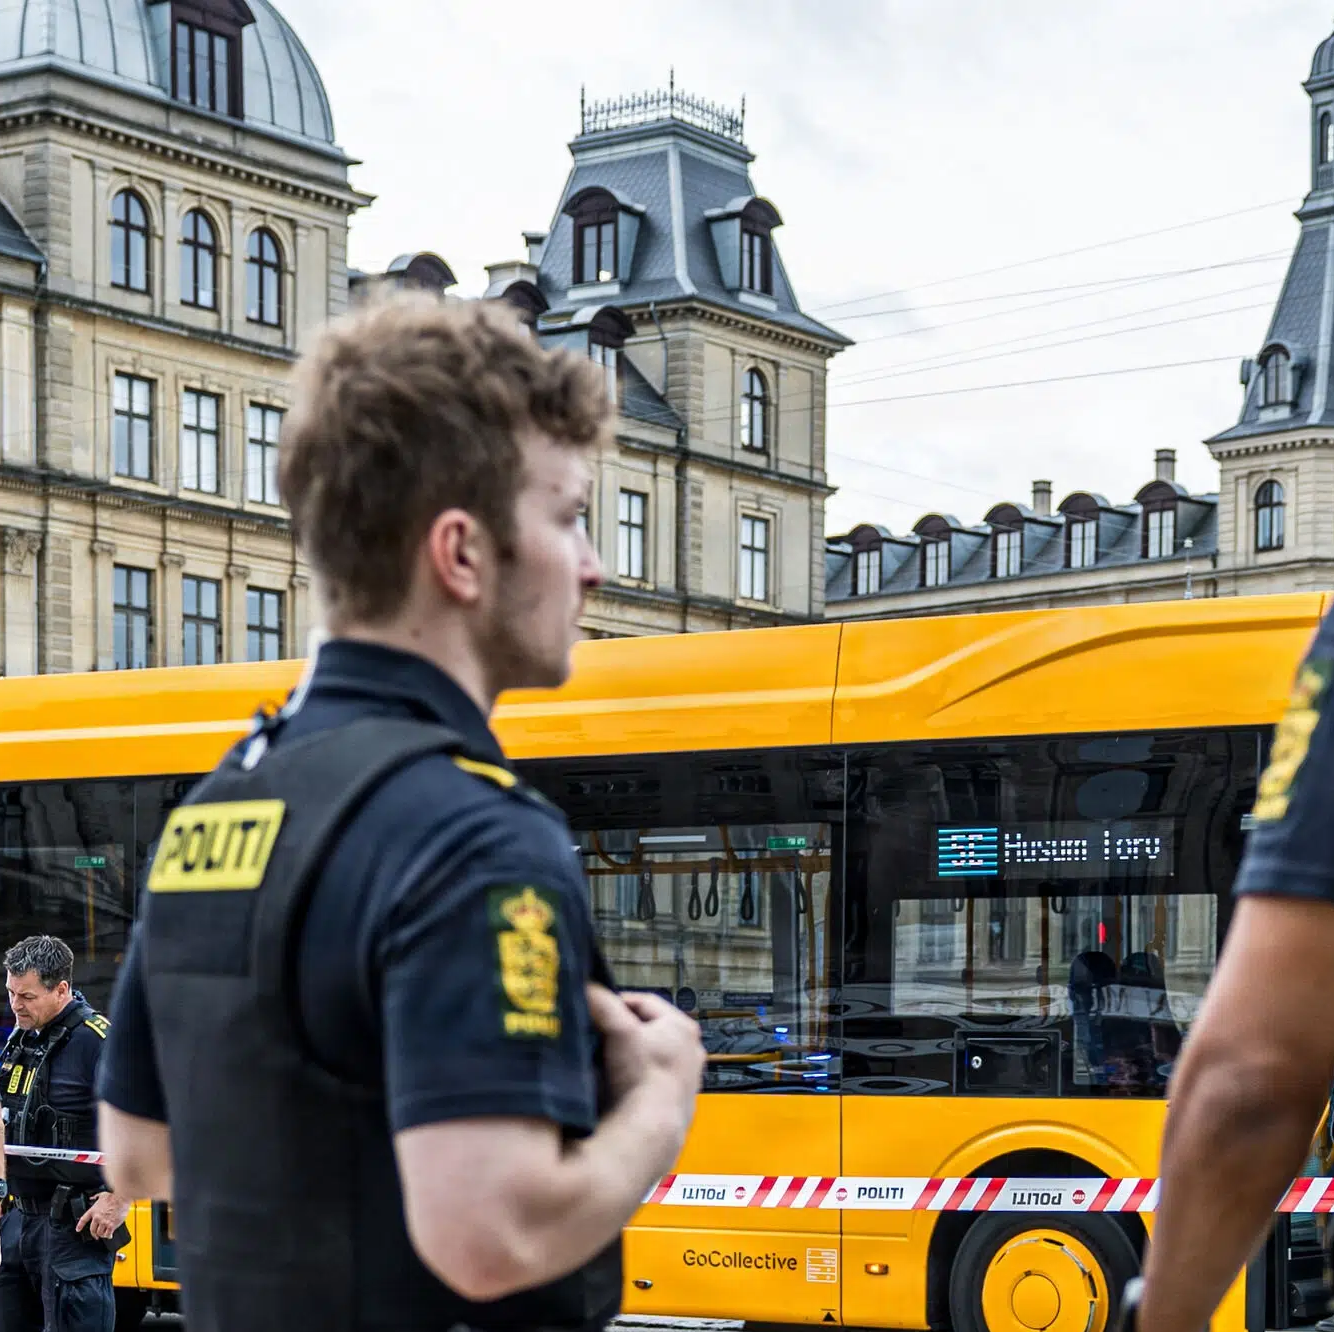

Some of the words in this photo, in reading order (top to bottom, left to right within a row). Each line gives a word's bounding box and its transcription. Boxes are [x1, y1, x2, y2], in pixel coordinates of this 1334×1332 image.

[161, 820, 271, 873] POLITI
[1004, 832, 1087, 863] Husum
[682, 1187, 726, 1200] POLITI
[857, 1187, 904, 1199] POLITI
[1012, 1192, 1063, 1205] POLITI
[683, 1249, 798, 1271] GoCollective
